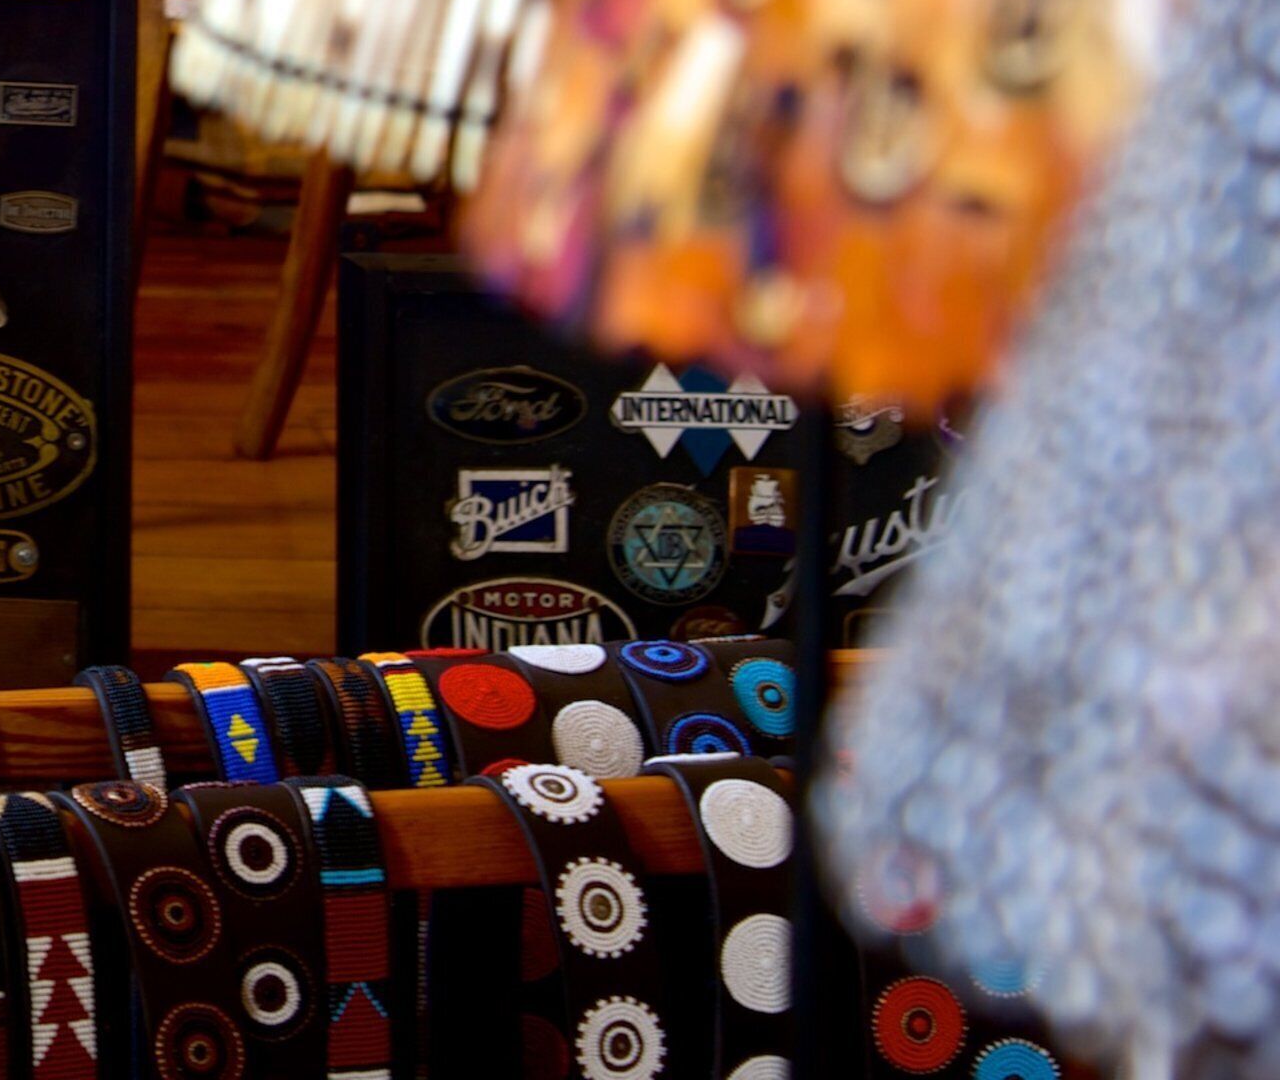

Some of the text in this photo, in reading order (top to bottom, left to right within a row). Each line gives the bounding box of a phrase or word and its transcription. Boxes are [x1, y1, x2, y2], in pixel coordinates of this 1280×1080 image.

[448, 380, 564, 422] Ford
[621, 397, 793, 424] INTERNATIONAL
[449, 463, 577, 562] Buick
[483, 591, 577, 609] MOTOR
